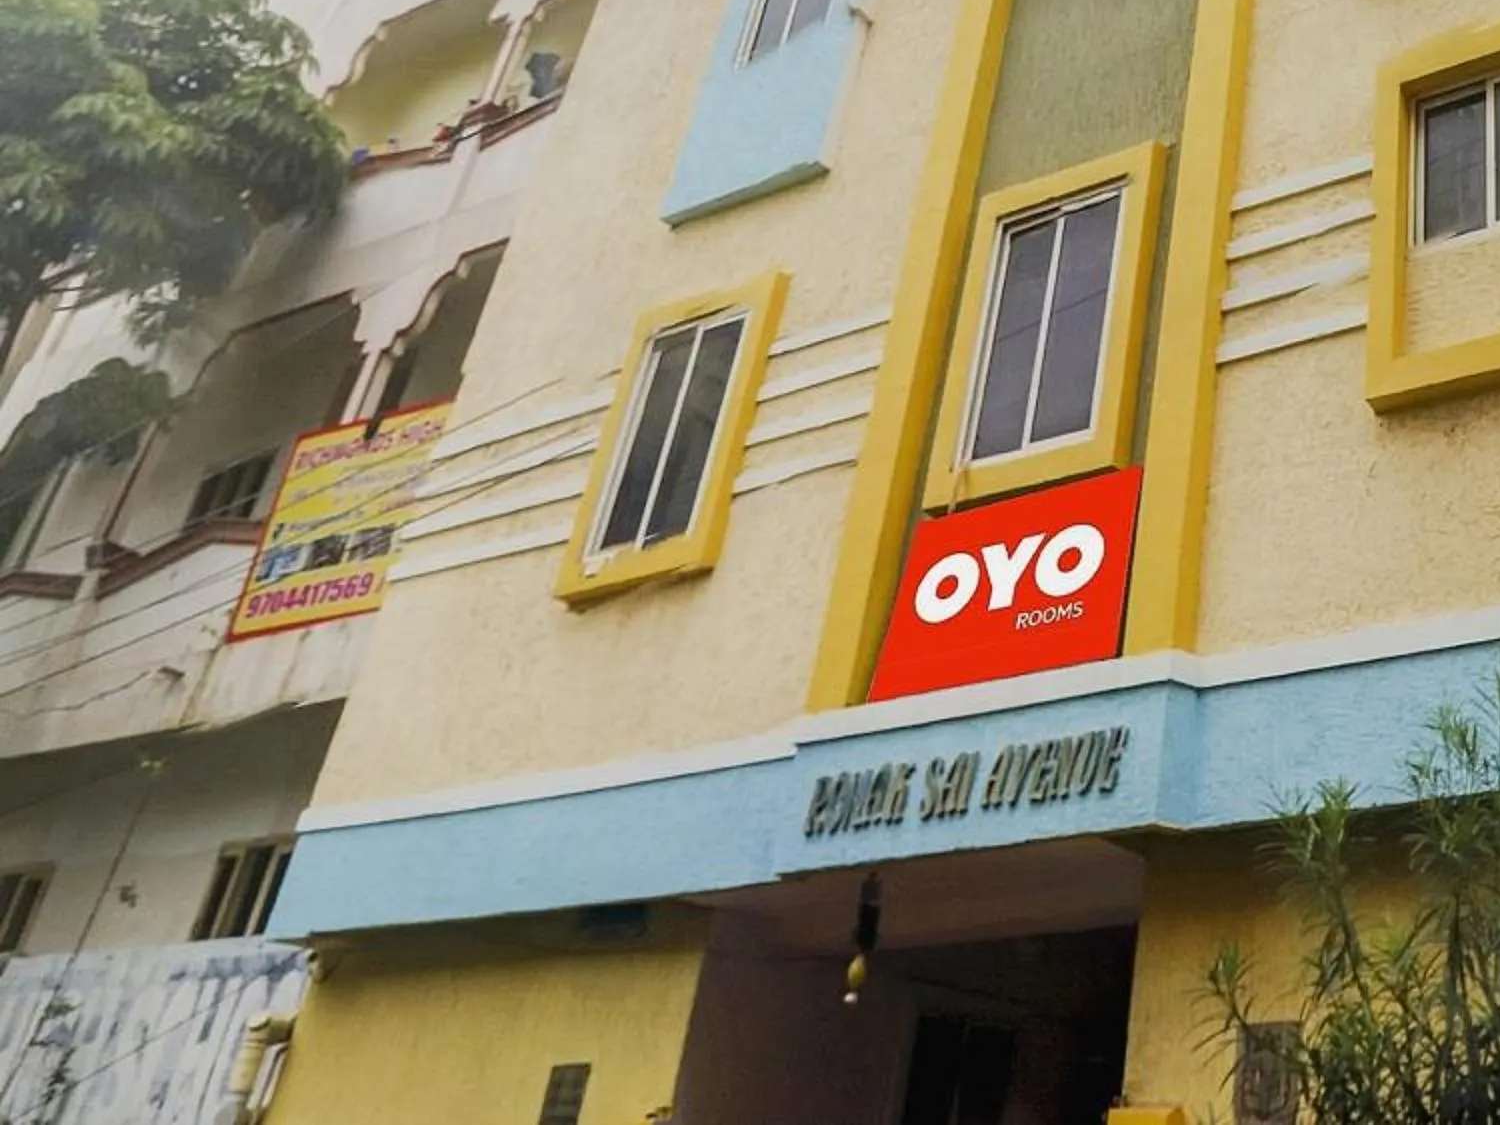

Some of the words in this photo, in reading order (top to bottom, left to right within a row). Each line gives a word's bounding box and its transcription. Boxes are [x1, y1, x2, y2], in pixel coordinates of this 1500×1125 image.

[914, 523, 1105, 624] OYO
[1015, 601, 1084, 629] ROOMS
[919, 751, 982, 822] SAI
[981, 726, 1132, 809] AVENUE
